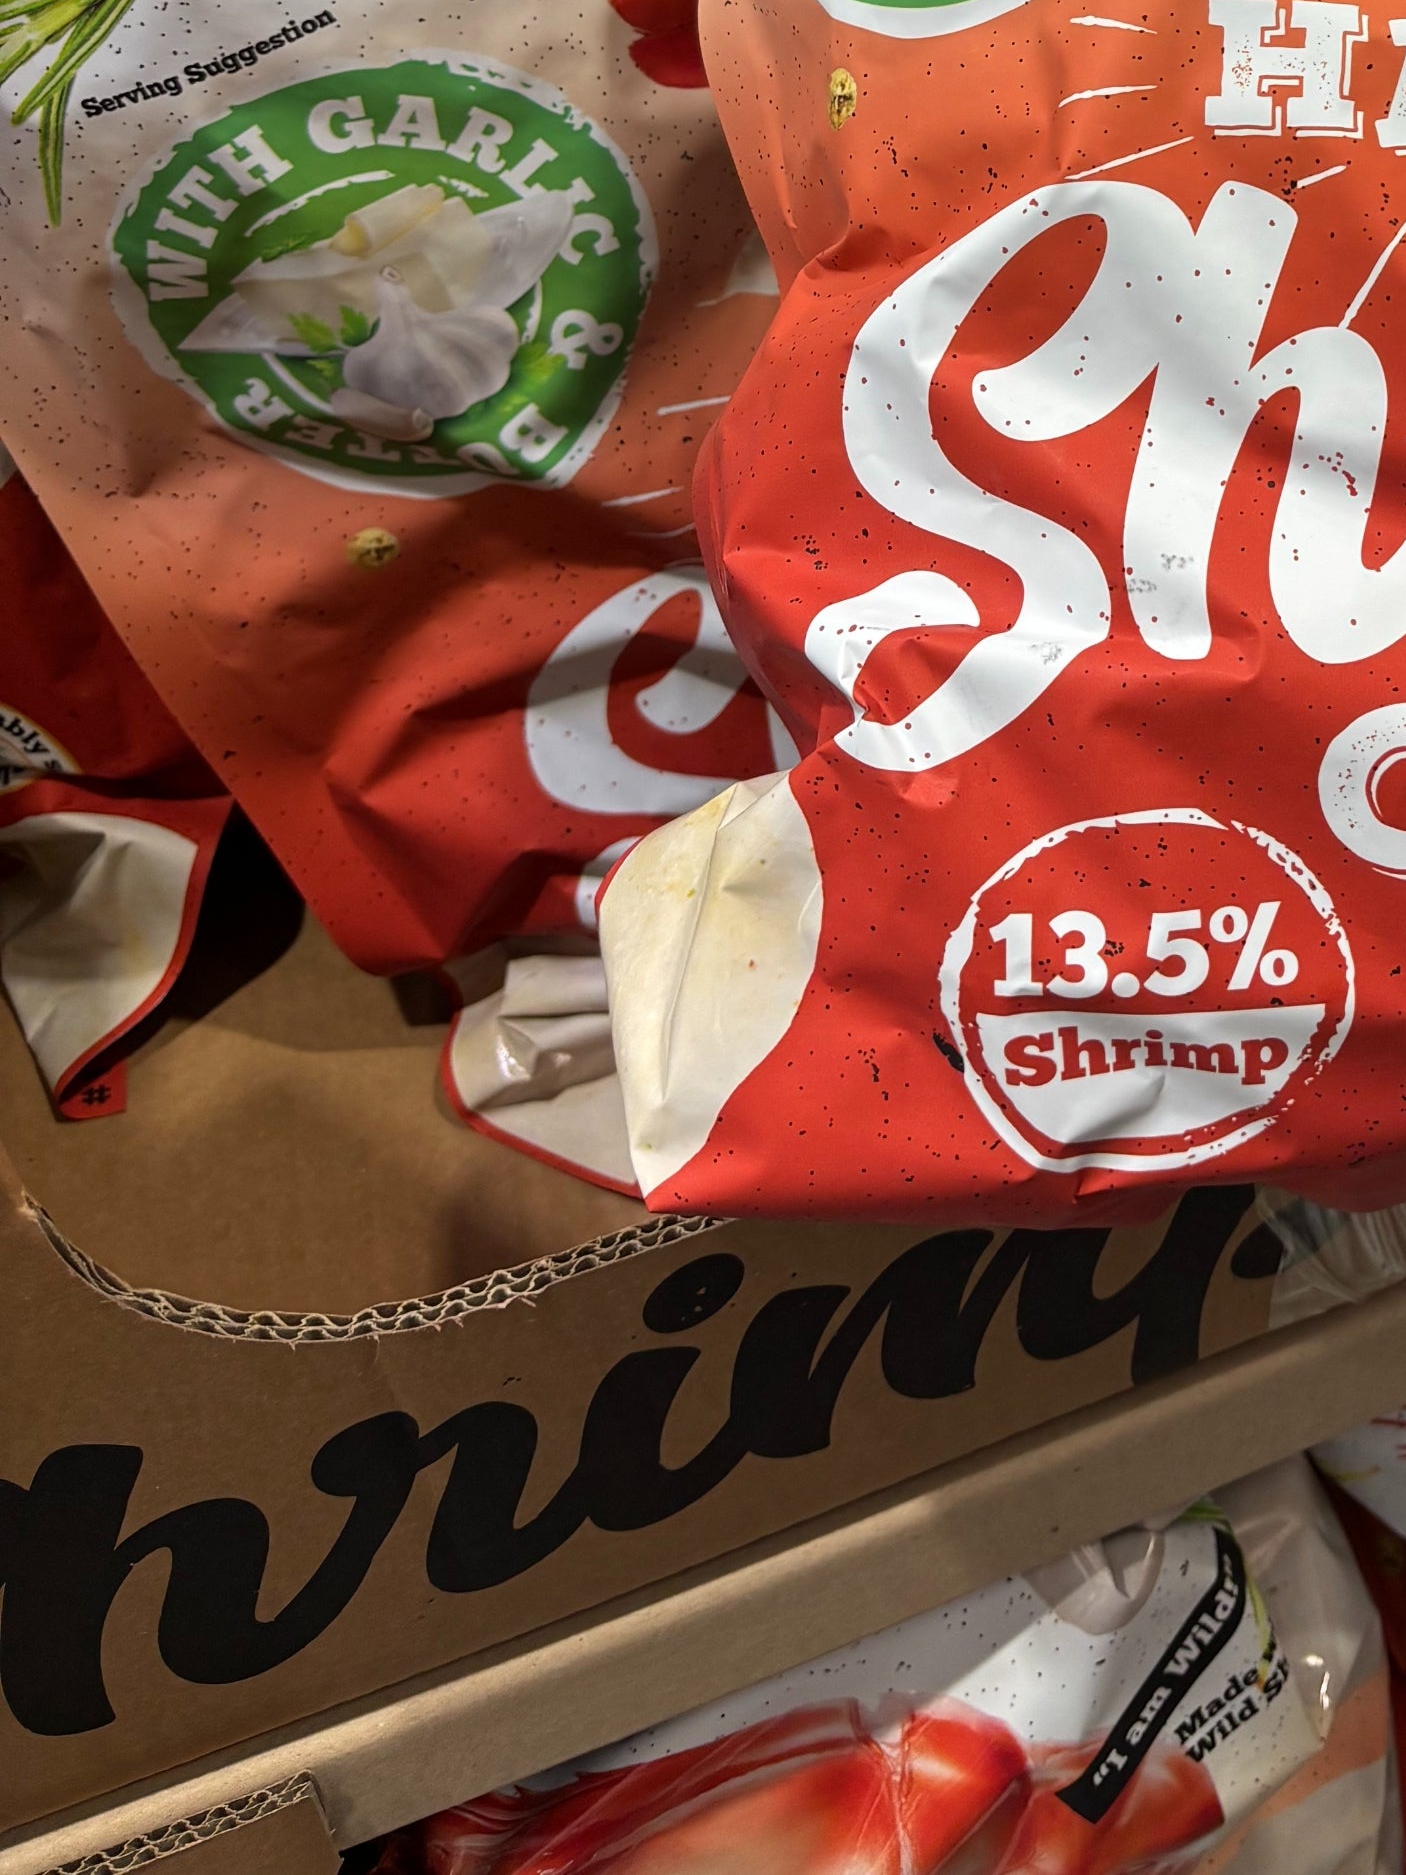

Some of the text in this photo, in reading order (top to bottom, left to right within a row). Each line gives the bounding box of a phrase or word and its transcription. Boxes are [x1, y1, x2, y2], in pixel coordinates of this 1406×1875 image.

[81, 6, 338, 121] Serving Suggestion
[148, 122, 295, 305] WITH
[306, 93, 621, 268] GARLIC
[550, 308, 625, 372] &
[988, 900, 1300, 1000] 13.5%
[1003, 1024, 1290, 1089] Shrimp
[1125, 1686, 1172, 1746] am
[1174, 1667, 1260, 1746] Made
[1185, 1694, 1260, 1764] Wild
